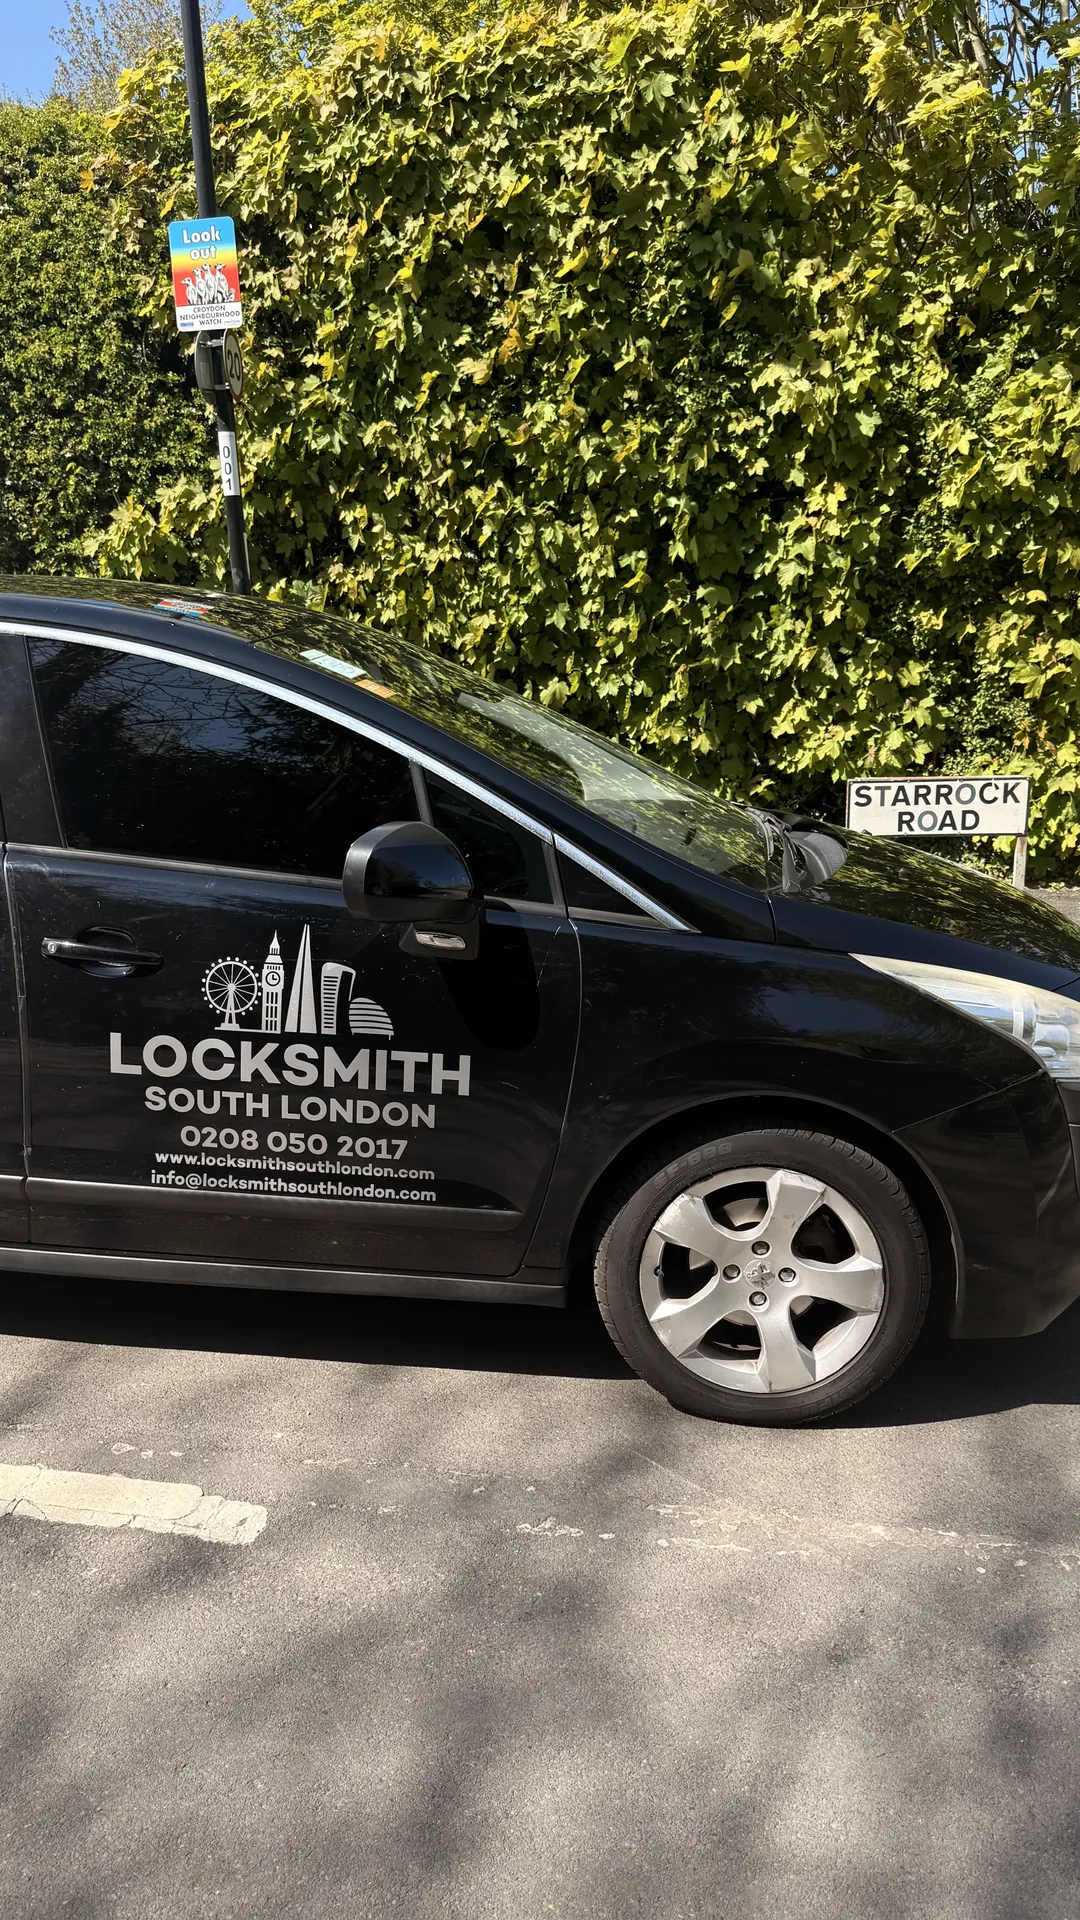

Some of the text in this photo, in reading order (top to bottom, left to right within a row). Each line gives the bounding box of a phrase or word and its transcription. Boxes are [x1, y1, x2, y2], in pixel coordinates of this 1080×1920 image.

[182, 225, 221, 244] Look
[190, 245, 217, 260] out
[180, 310, 240, 321] NEIGHBOURHOOD
[193, 305, 226, 313] CROYDON
[227, 349, 241, 381] 20
[854, 782, 1021, 807] STARROCK
[897, 809, 980, 832] ROAD
[109, 1031, 471, 1096] LOCKSMITH
[144, 1085, 436, 1129] SOUTH LONDON
[180, 1125, 408, 1160] 0208 050 2017
[155, 1152, 435, 1180] www.locksmithsouthlondon.com
[151, 1169, 437, 1202] info@locksmithsouthlondon.com
